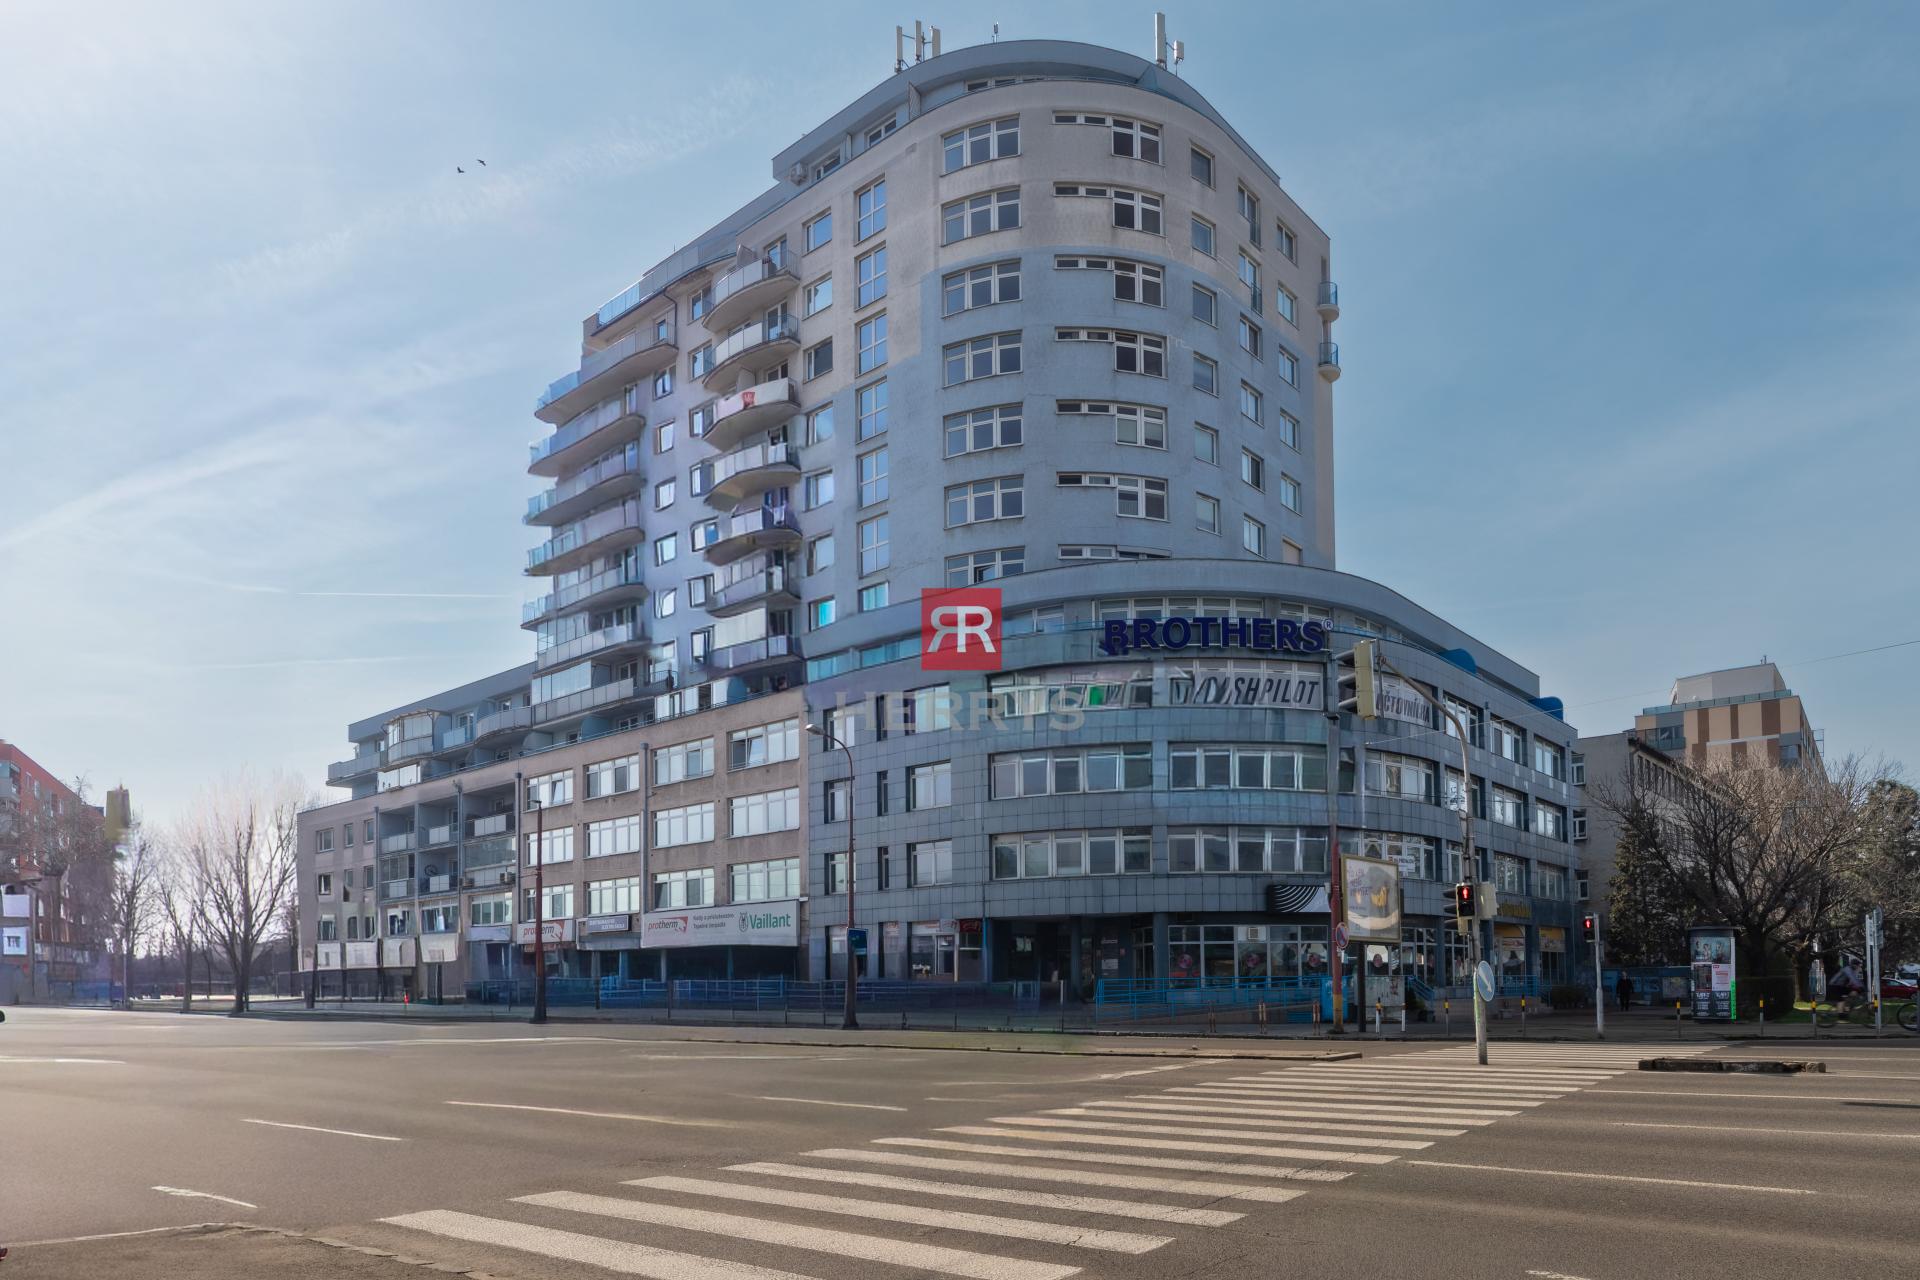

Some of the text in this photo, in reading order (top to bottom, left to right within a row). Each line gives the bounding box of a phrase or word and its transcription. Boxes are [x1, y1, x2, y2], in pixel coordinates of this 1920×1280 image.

[648, 920, 679, 932] protherm
[749, 913, 791, 929] Vaillant
[522, 925, 555, 938] proerm
